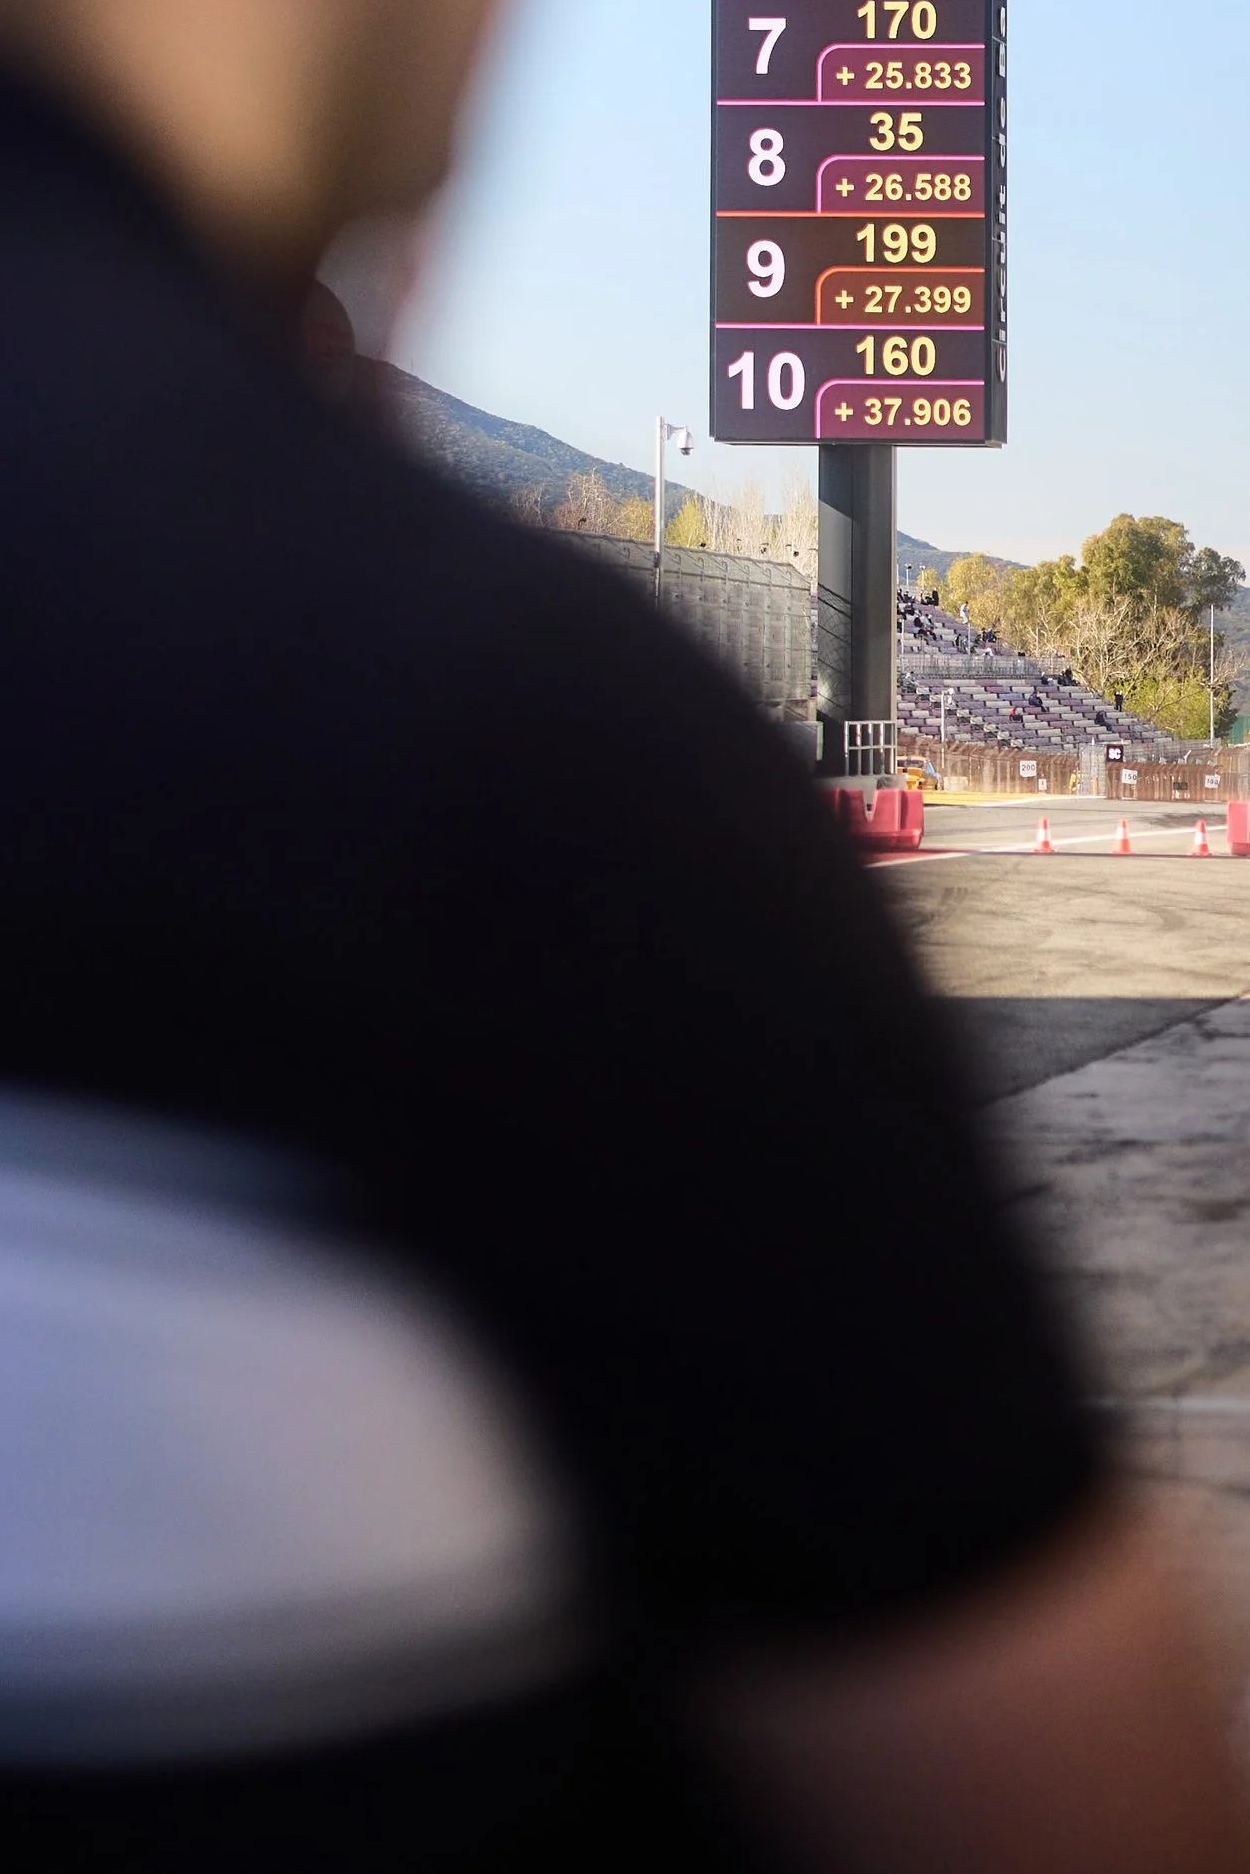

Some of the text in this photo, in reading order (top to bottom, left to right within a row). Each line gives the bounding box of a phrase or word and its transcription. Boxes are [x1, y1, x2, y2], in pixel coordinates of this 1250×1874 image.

[858, 2, 936, 39] 170
[749, 18, 786, 74] 7
[837, 62, 971, 89] + 25.833
[870, 113, 923, 151] 35
[749, 129, 785, 186] 8
[836, 174, 971, 200] + 26.588
[857, 224, 936, 263] 199
[747, 240, 785, 297] 9
[836, 286, 970, 313] + 27.399
[857, 336, 935, 375] 160
[729, 352, 805, 410] 10
[835, 398, 971, 426] + 37.906
[1109, 747, 1121, 759] SC
